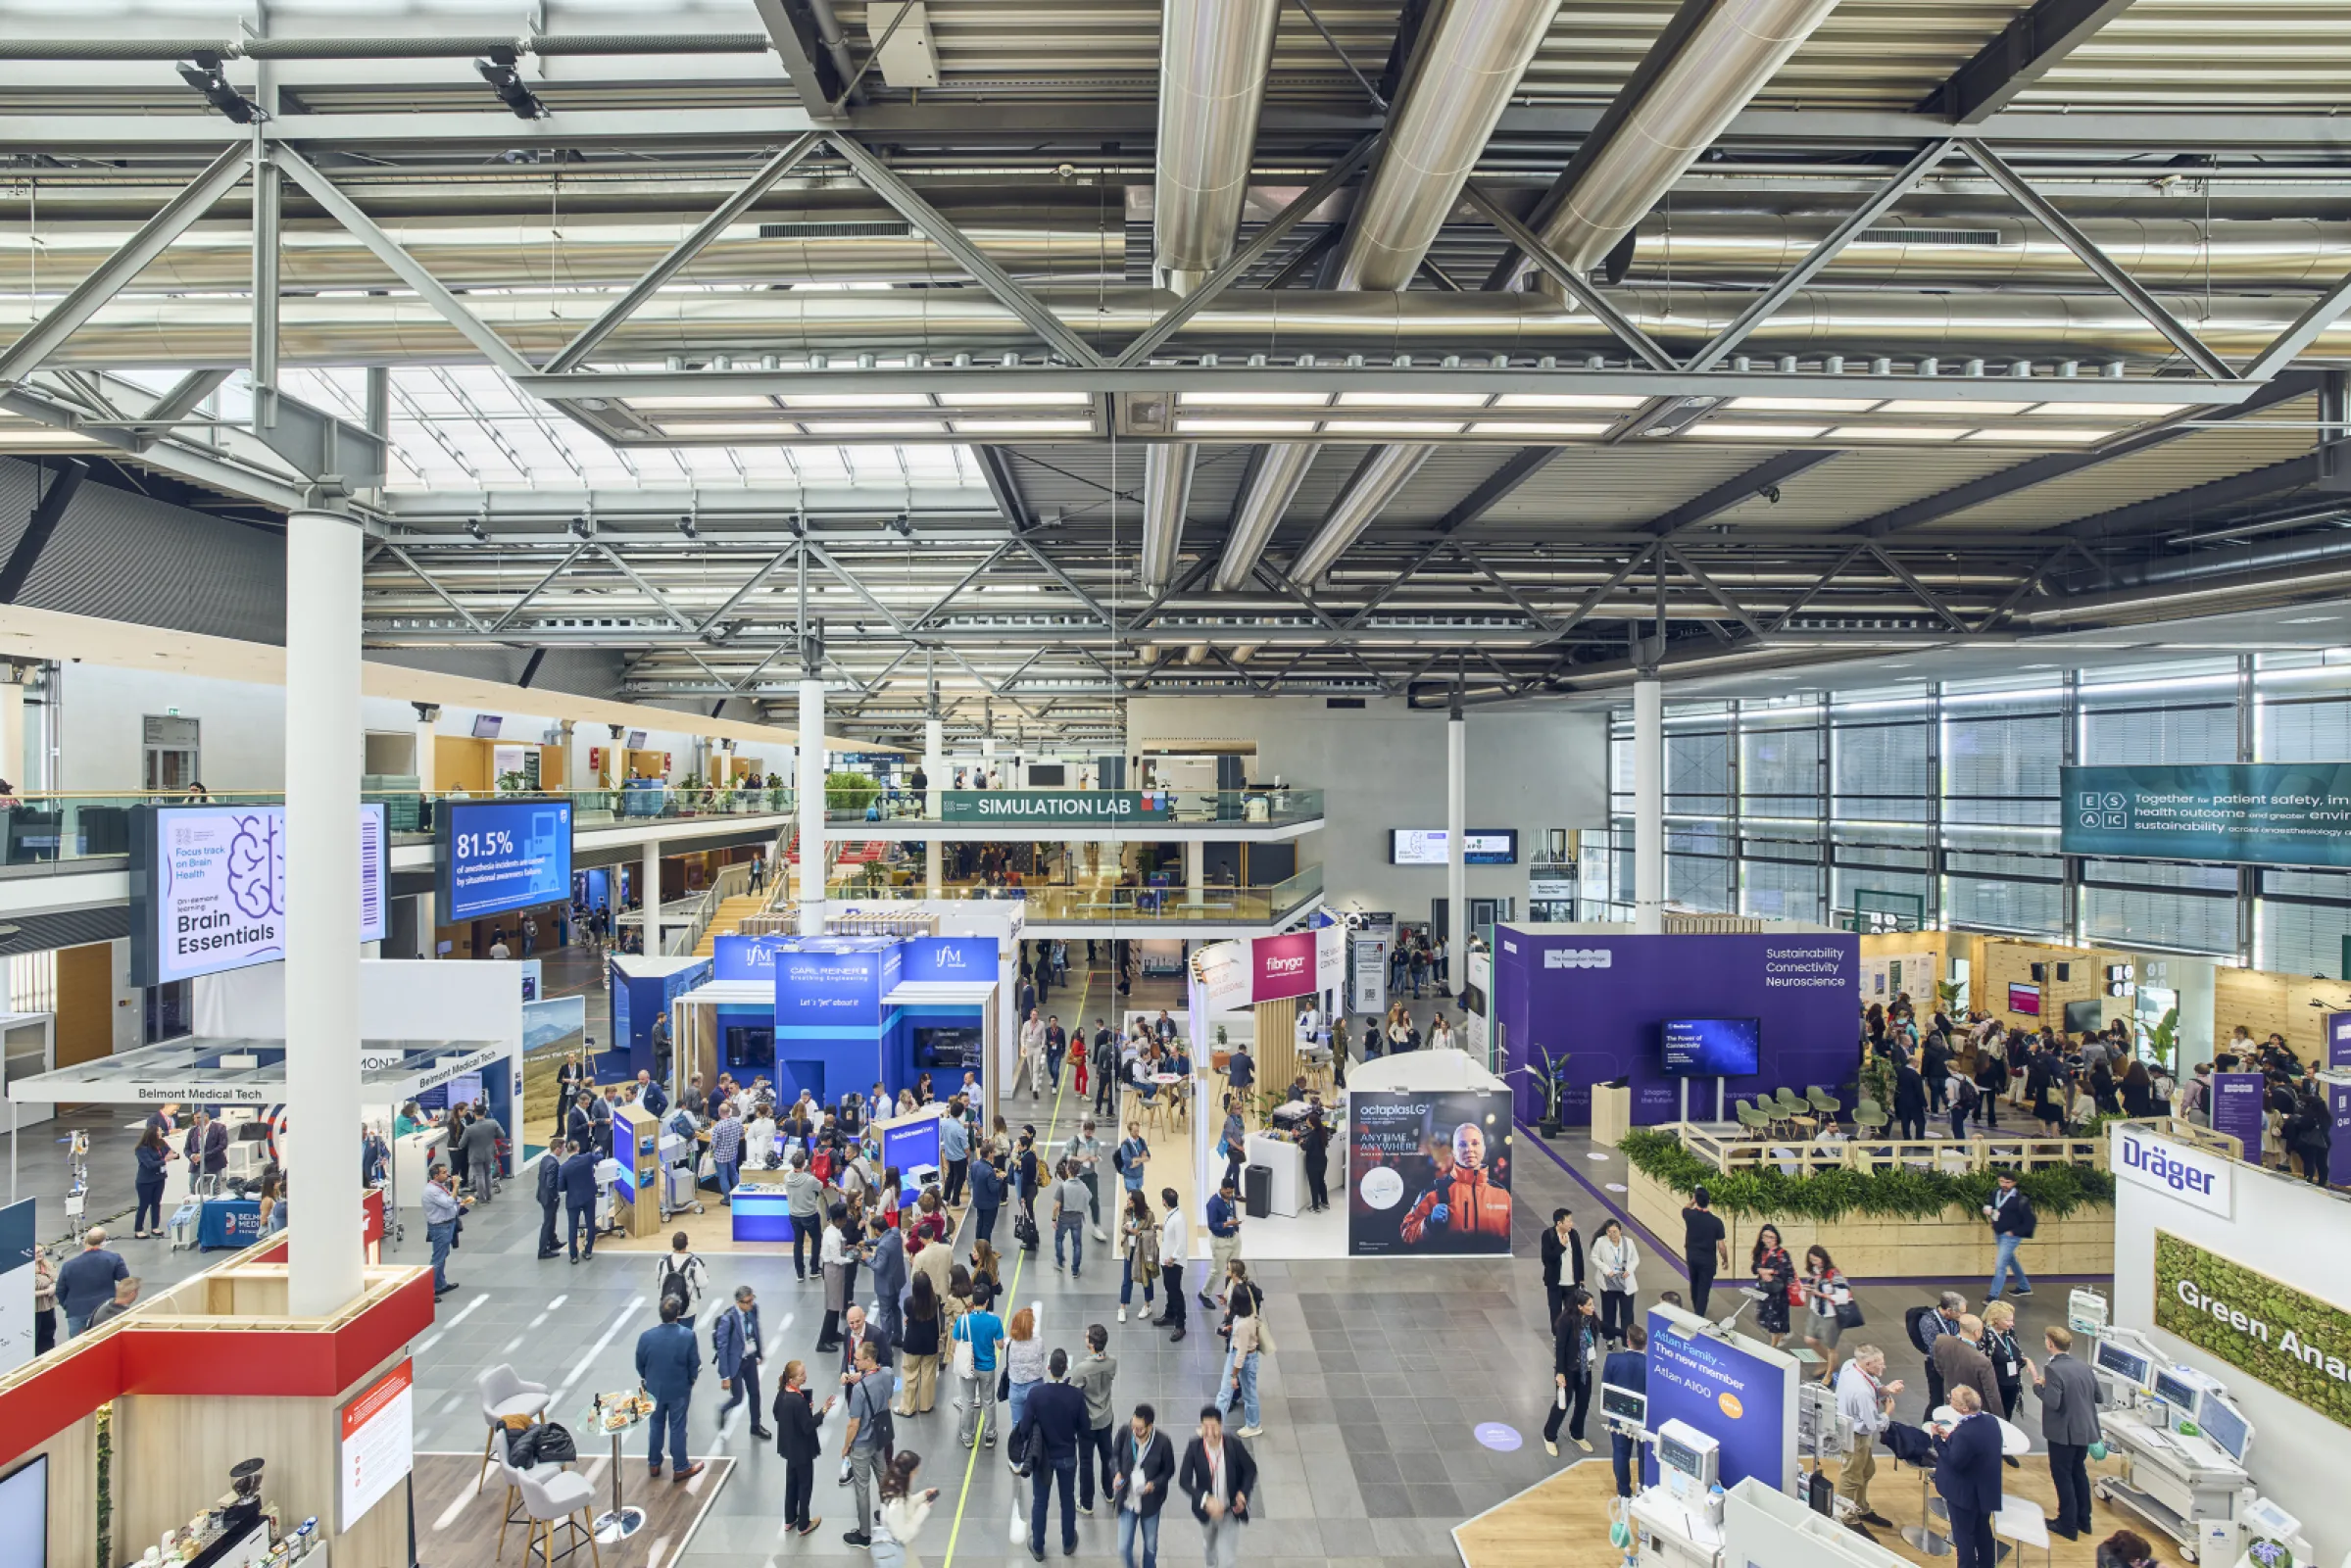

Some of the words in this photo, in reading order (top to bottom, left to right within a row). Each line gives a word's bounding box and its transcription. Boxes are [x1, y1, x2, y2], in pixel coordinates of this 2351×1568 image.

[978, 799, 1092, 815] SIMULATION
[1097, 799, 1131, 815] LAB
[2086, 796, 2094, 806] E
[2110, 796, 2118, 806] S
[2134, 793, 2194, 805] Together
[2213, 794, 2266, 806] patient
[2271, 794, 2324, 807] safety,
[2328, 795, 2349, 805] im
[2086, 815, 2095, 824] A
[2108, 815, 2121, 824] IC
[2134, 807, 2177, 816] health
[2180, 808, 2245, 818] outcome
[2134, 821, 2225, 834] sustainability
[2261, 827, 2342, 837] anaesthesiology
[176, 847, 201, 857] Focus
[204, 845, 225, 855] track
[457, 830, 513, 859] 81.5%
[189, 858, 212, 867] Brain
[176, 870, 205, 879] Health
[178, 909, 230, 933] Brain
[179, 924, 274, 955] Essentials
[1766, 947, 1844, 961] Sustainability
[1766, 962, 1839, 974] Connectivity
[1766, 976, 1845, 987] Neuroscience
[420, 1068, 451, 1088] Belmont
[452, 1056, 479, 1074] Medical
[139, 1089, 186, 1098] Belmont
[189, 1089, 232, 1098] Medical
[235, 1089, 262, 1099] Tech
[2123, 1136, 2215, 1195] Dräger
[2177, 1280, 2268, 1342] Green
[2279, 1331, 2351, 1383] Ana
[1654, 1329, 1681, 1349] Atlan
[1683, 1341, 1717, 1366] Family
[1654, 1341, 1674, 1358] The
[1675, 1353, 1698, 1369] new
[1698, 1363, 1745, 1391] member
[1654, 1364, 1682, 1385] Atlan
